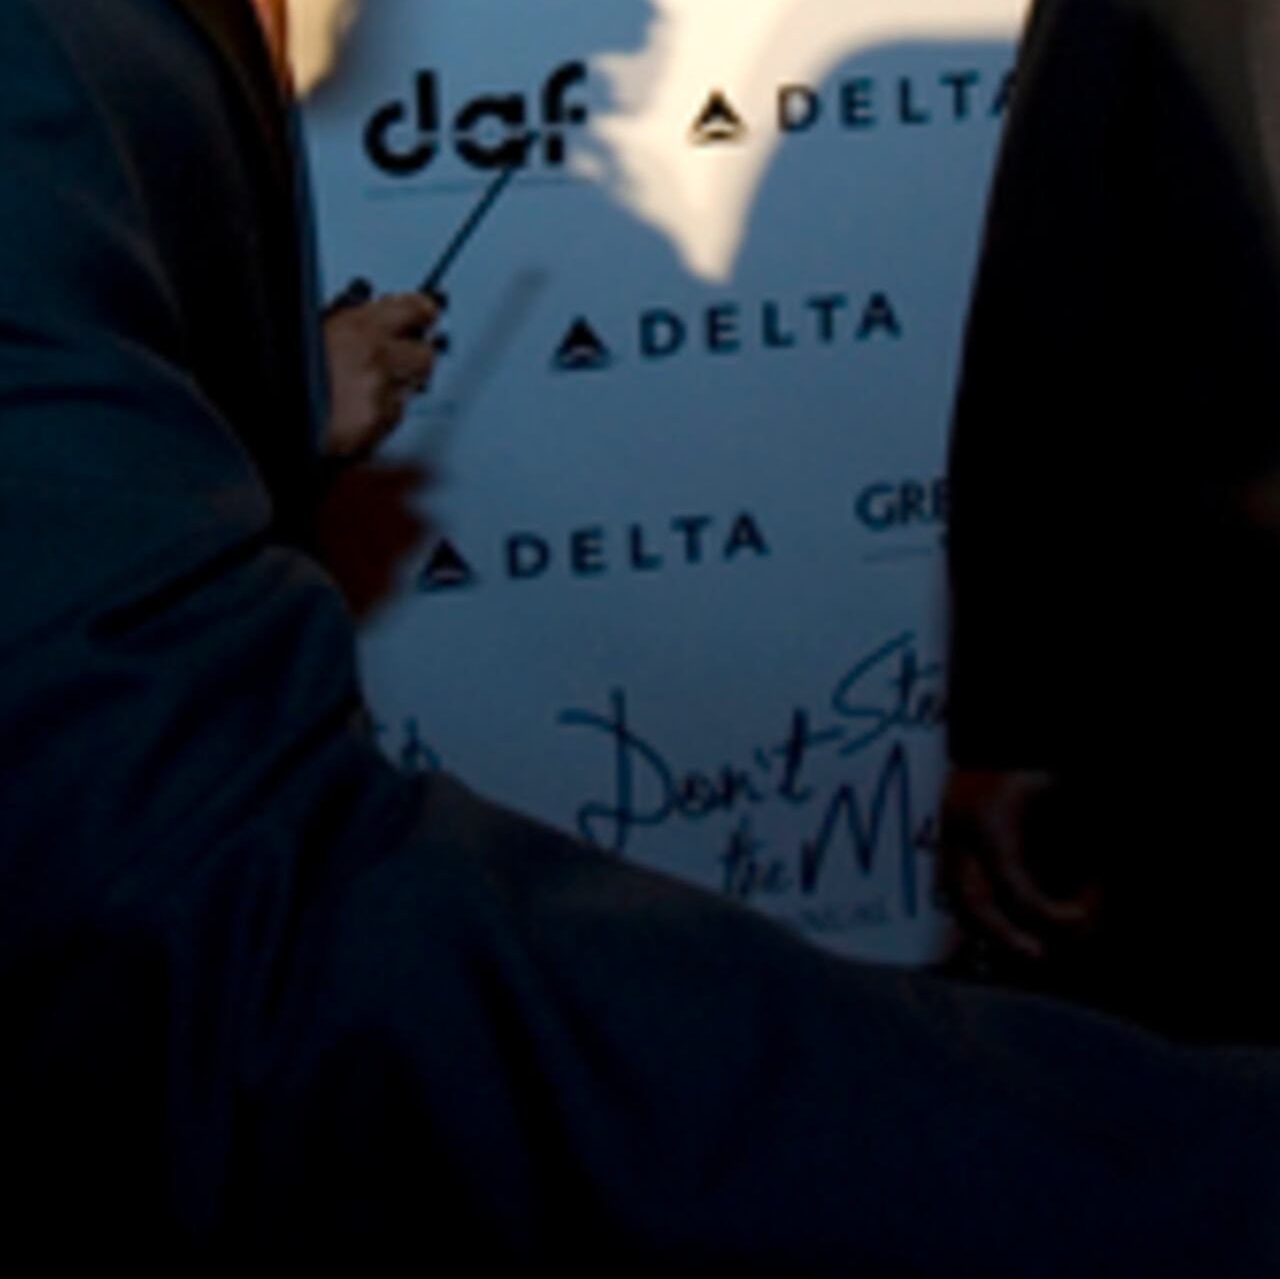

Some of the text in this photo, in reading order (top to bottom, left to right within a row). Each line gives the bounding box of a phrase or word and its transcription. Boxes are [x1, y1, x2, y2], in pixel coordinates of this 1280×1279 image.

[363, 59, 588, 177] daf
[638, 291, 902, 361] DELTA
[503, 509, 771, 581] DELTA
